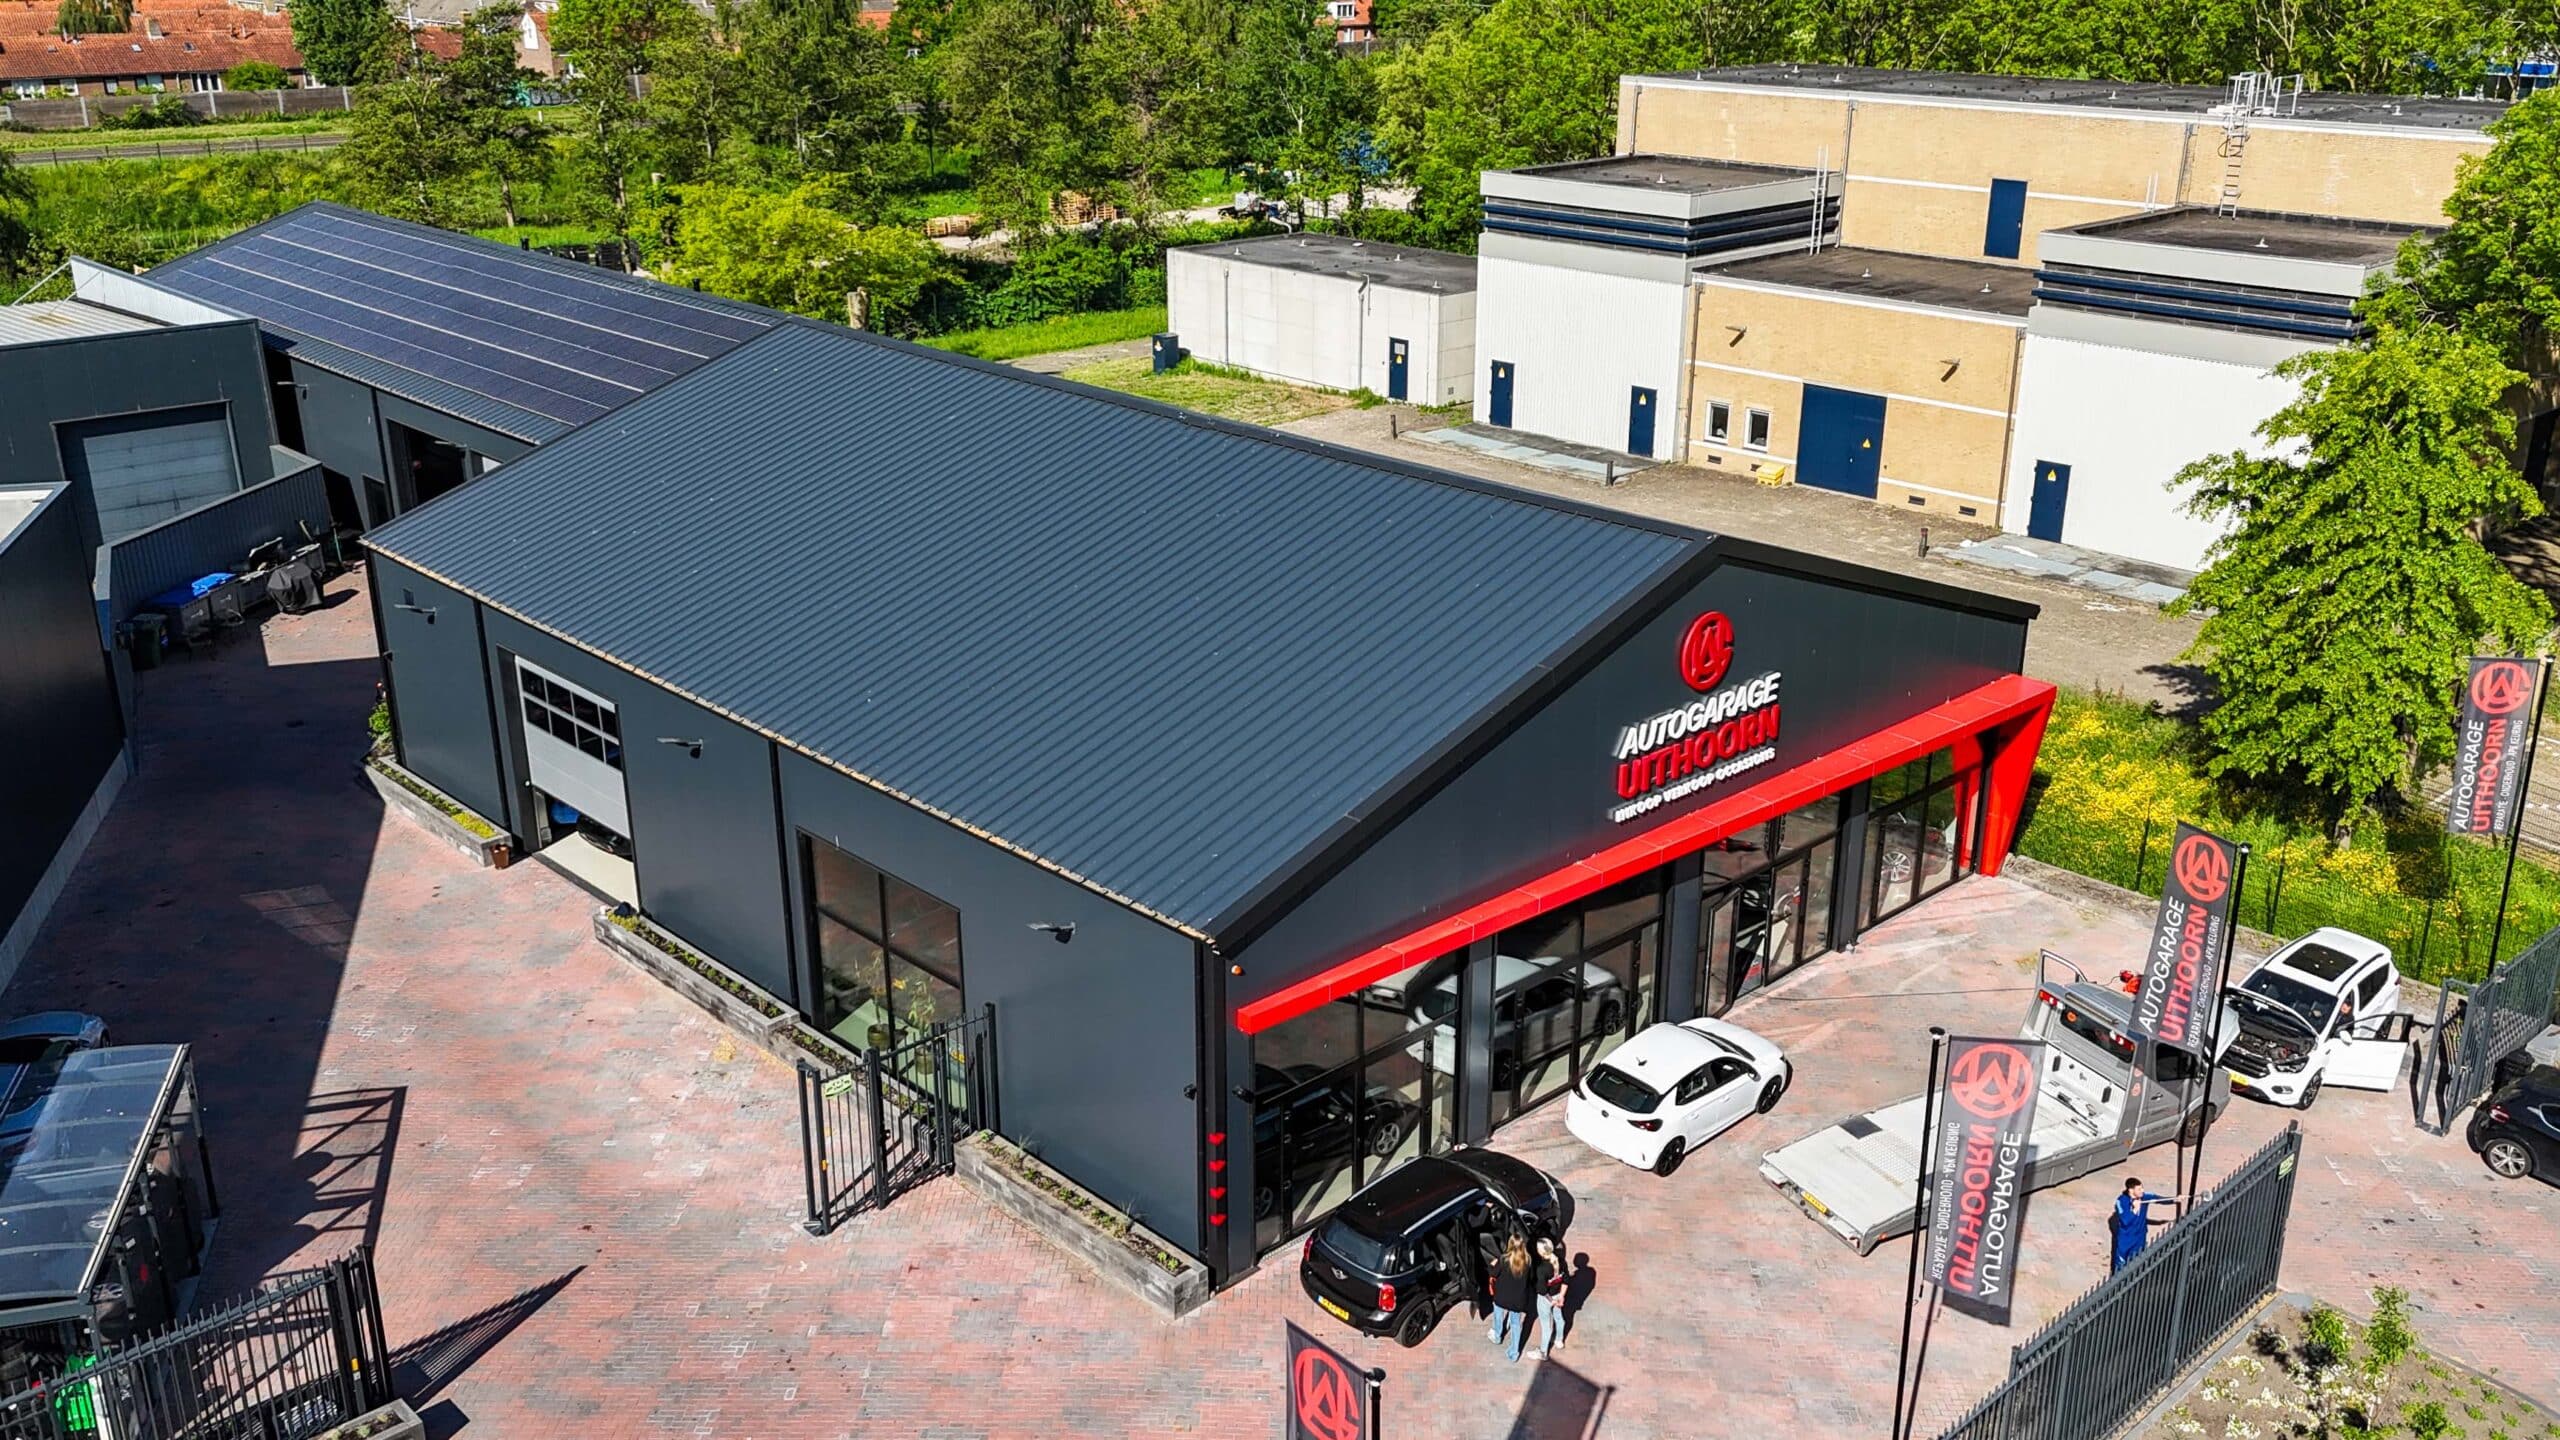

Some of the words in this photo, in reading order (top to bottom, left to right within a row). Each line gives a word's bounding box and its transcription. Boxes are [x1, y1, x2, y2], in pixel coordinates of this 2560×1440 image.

[1616, 671, 1781, 759] AUTOGARAGE
[1617, 704, 1781, 799] UITHOORN
[1615, 794, 1662, 823] INKOOP
[1663, 773, 1715, 802] VERKOOP
[1715, 747, 1776, 780] OCCASIONS
[2454, 719, 2484, 830] AUTOGARAGE
[2472, 718, 2508, 832] UITHOORN
[2138, 896, 2185, 1033] AUTOGARAGE
[2159, 904, 2208, 1043] UITHOORN
[2207, 915, 2220, 945] KEURING
